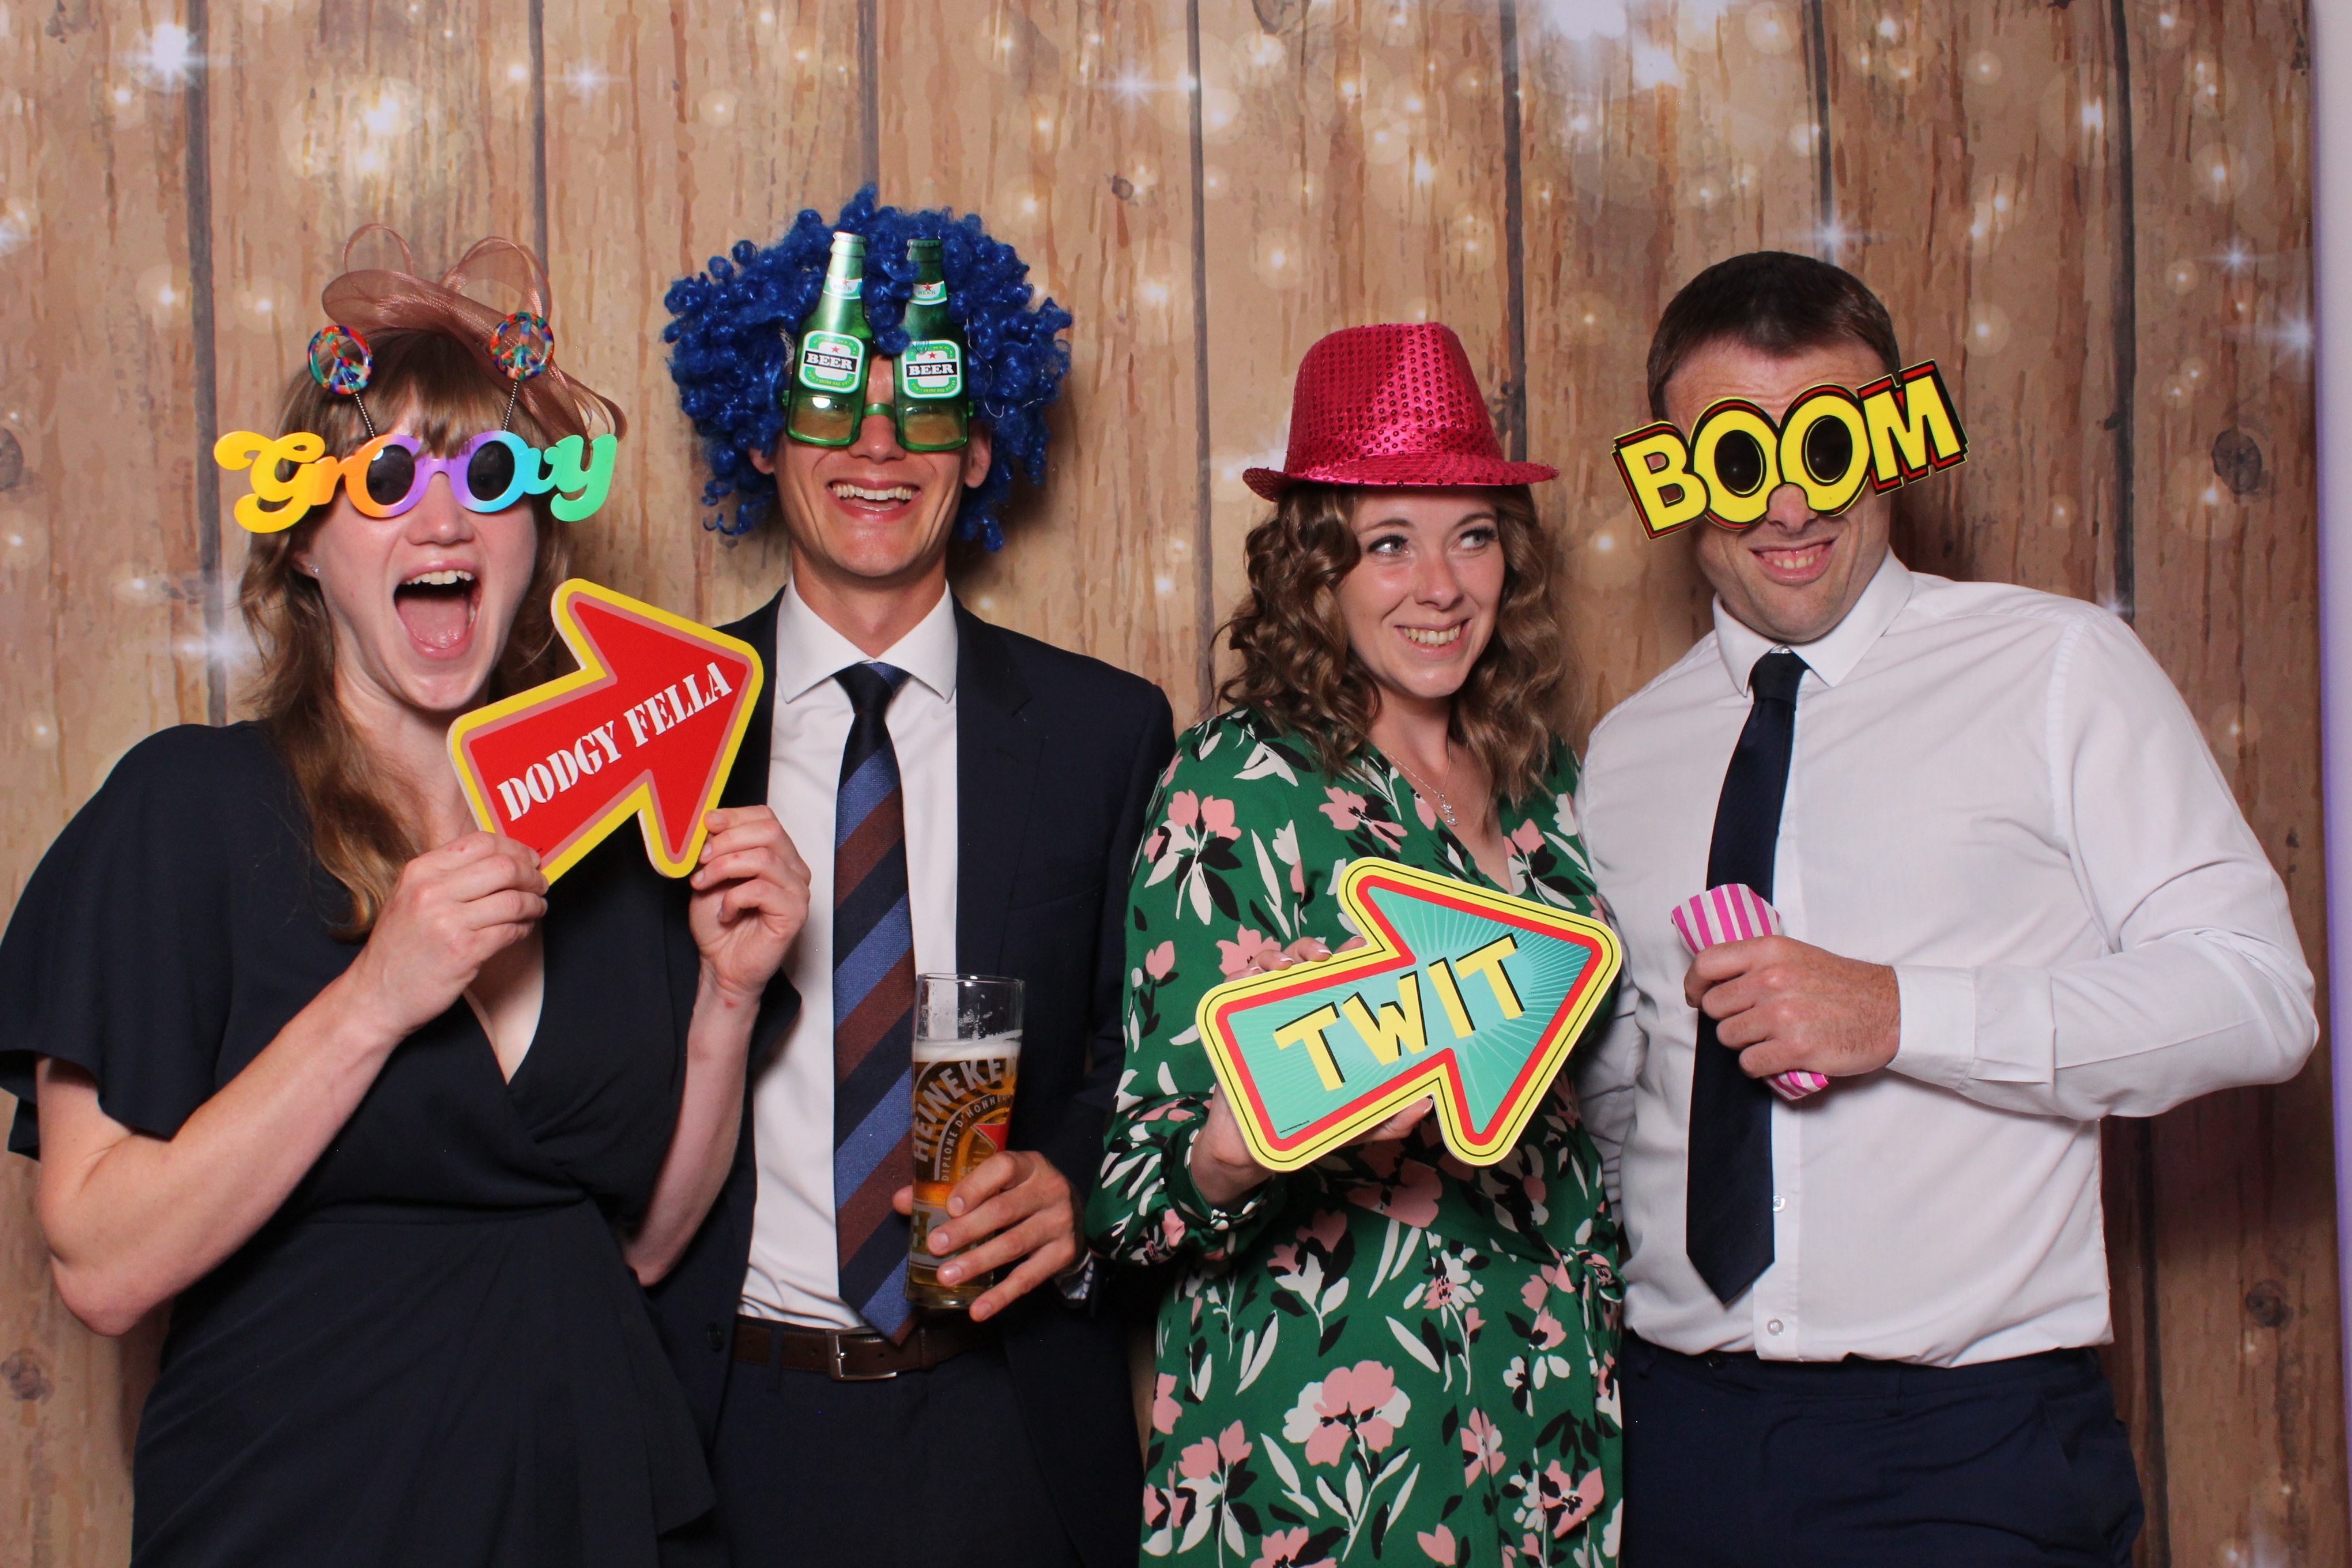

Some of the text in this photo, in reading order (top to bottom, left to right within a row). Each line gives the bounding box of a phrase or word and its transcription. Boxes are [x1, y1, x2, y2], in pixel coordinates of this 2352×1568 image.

[806, 353, 853, 370] BEER
[909, 363, 954, 376] BEER
[1614, 364, 1965, 536] BOOM
[497, 662, 733, 821] DODGY FELLA
[1273, 932, 1526, 1092] TWIT
[913, 1055, 1018, 1162] HEINEKEN
[941, 1130, 958, 1181] DIPLOME
[955, 1094, 1010, 1128] D'HONNEU
